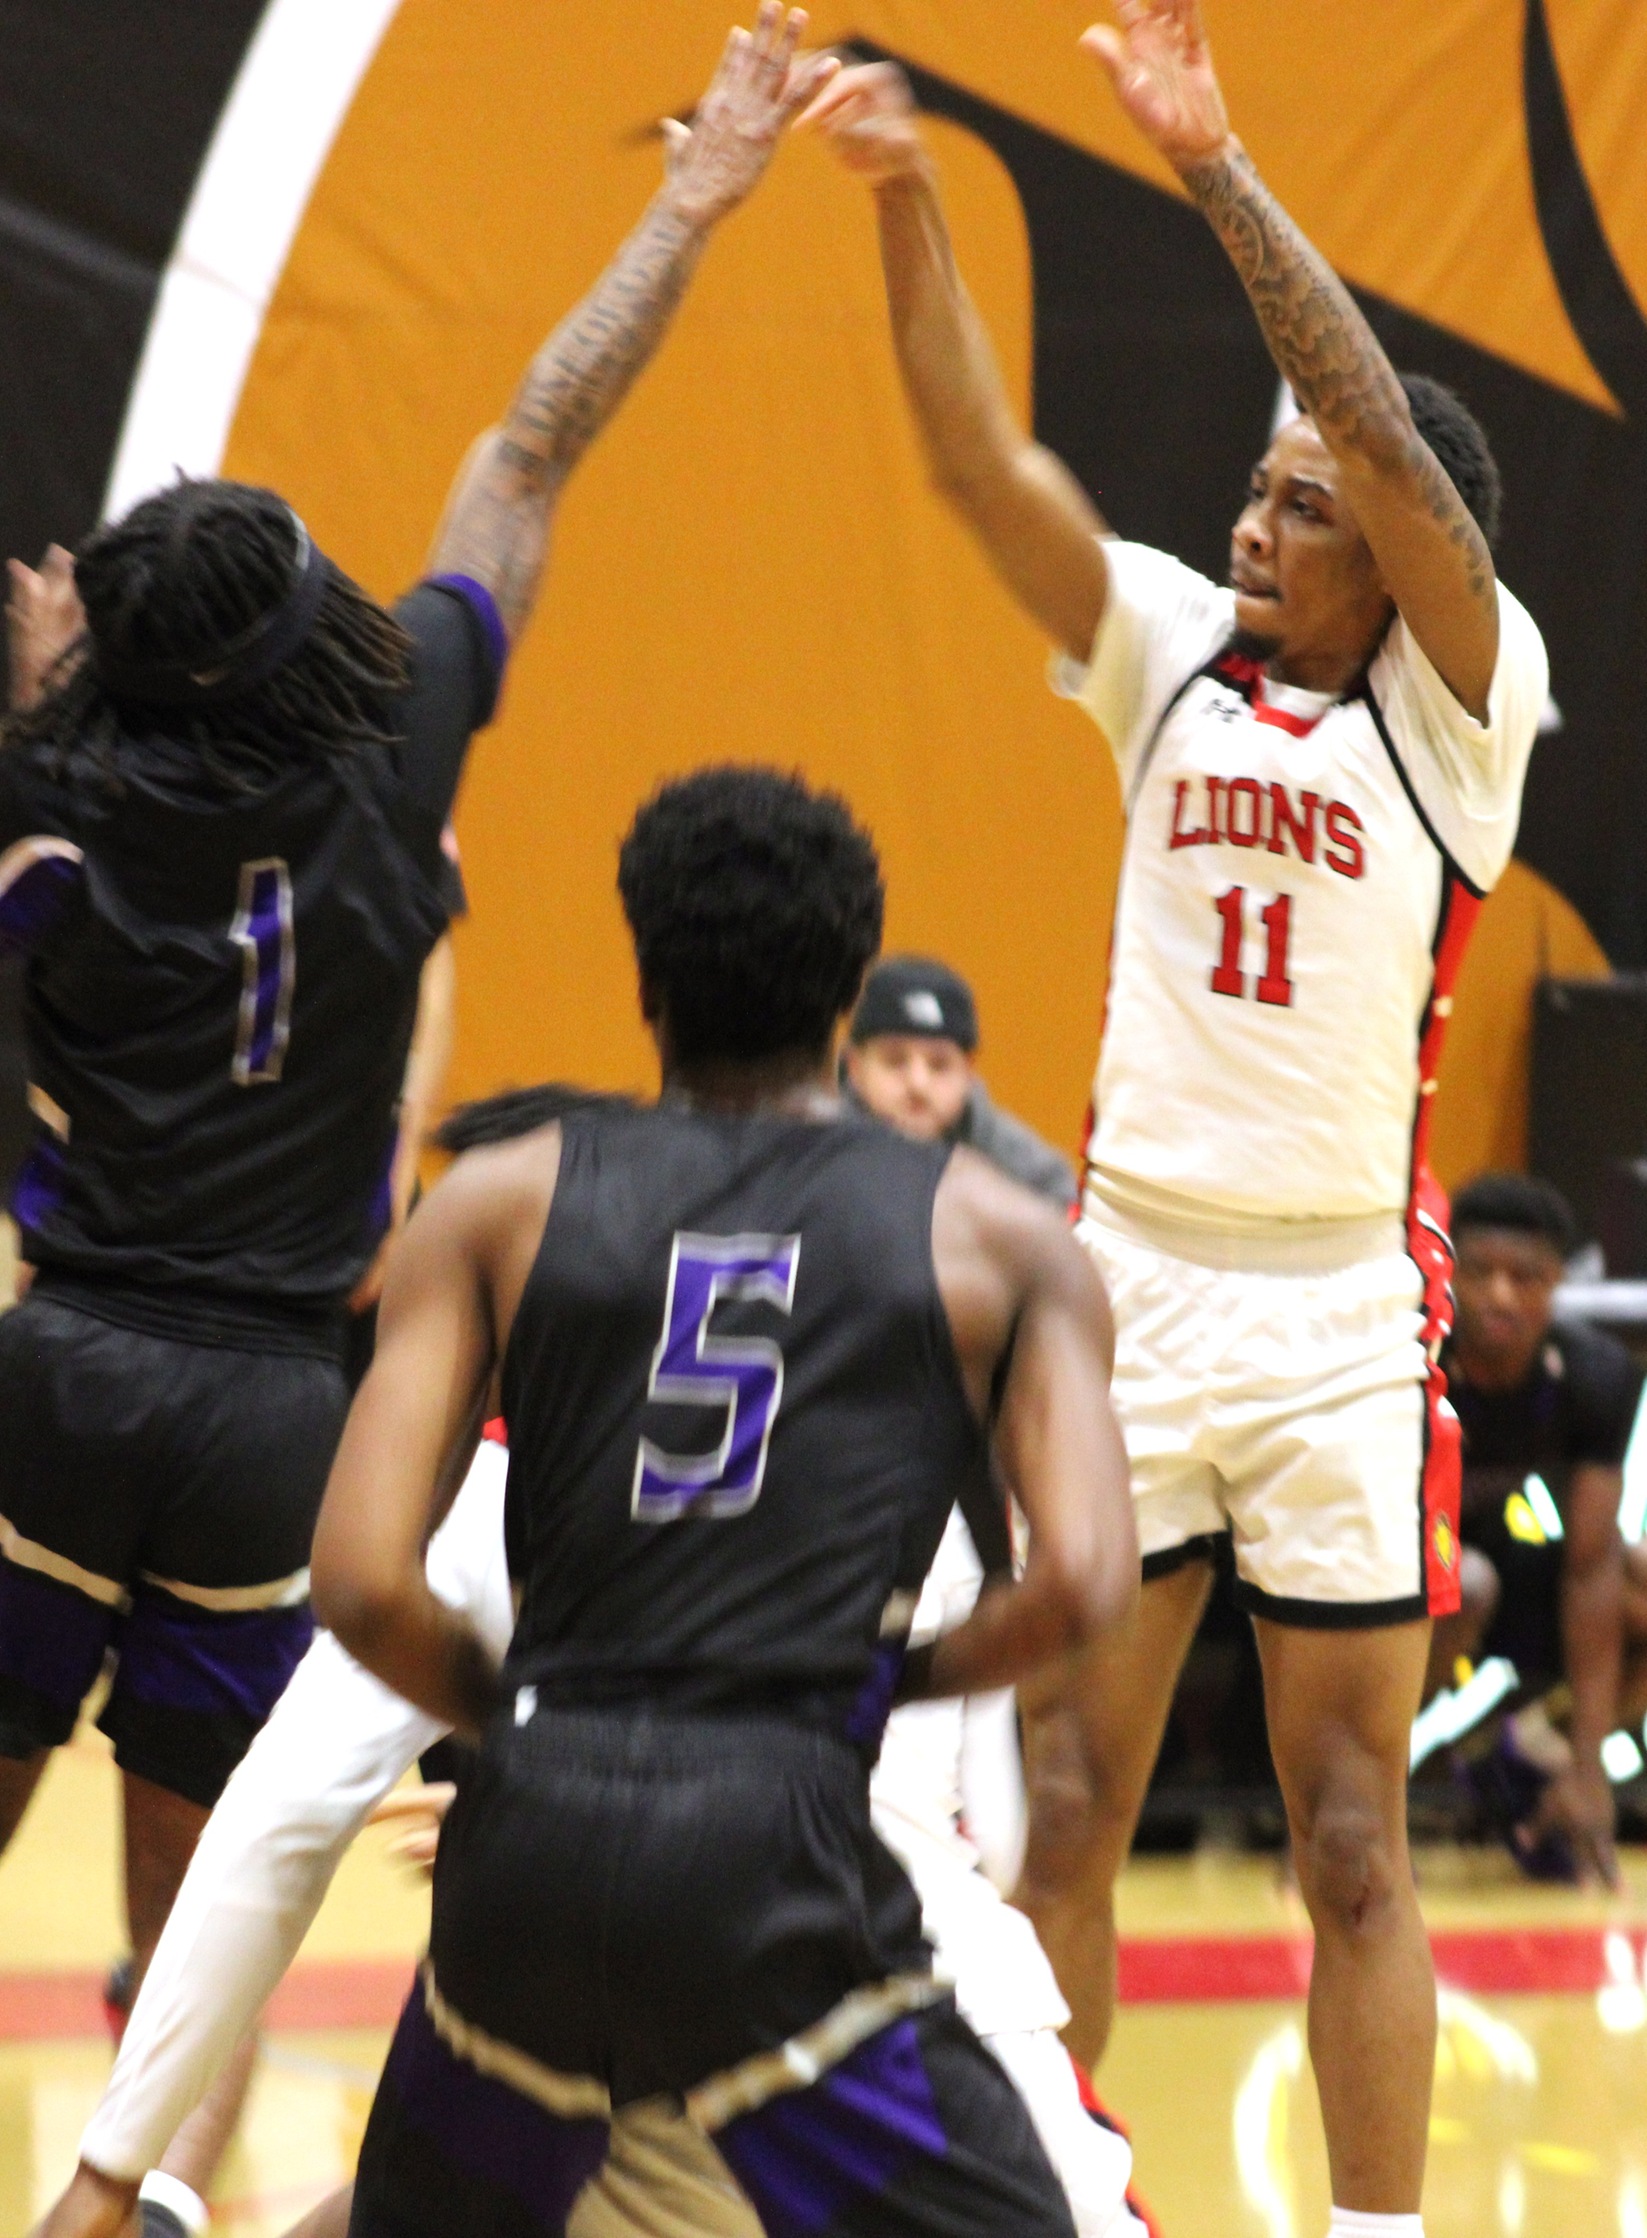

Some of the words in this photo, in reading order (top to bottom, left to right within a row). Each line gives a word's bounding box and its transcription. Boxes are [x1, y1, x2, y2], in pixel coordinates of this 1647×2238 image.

[1169, 777, 1367, 880] LIONS
[228, 856, 296, 1088] 1
[1211, 885, 1294, 1008] 11
[631, 1230, 801, 1523] 5
